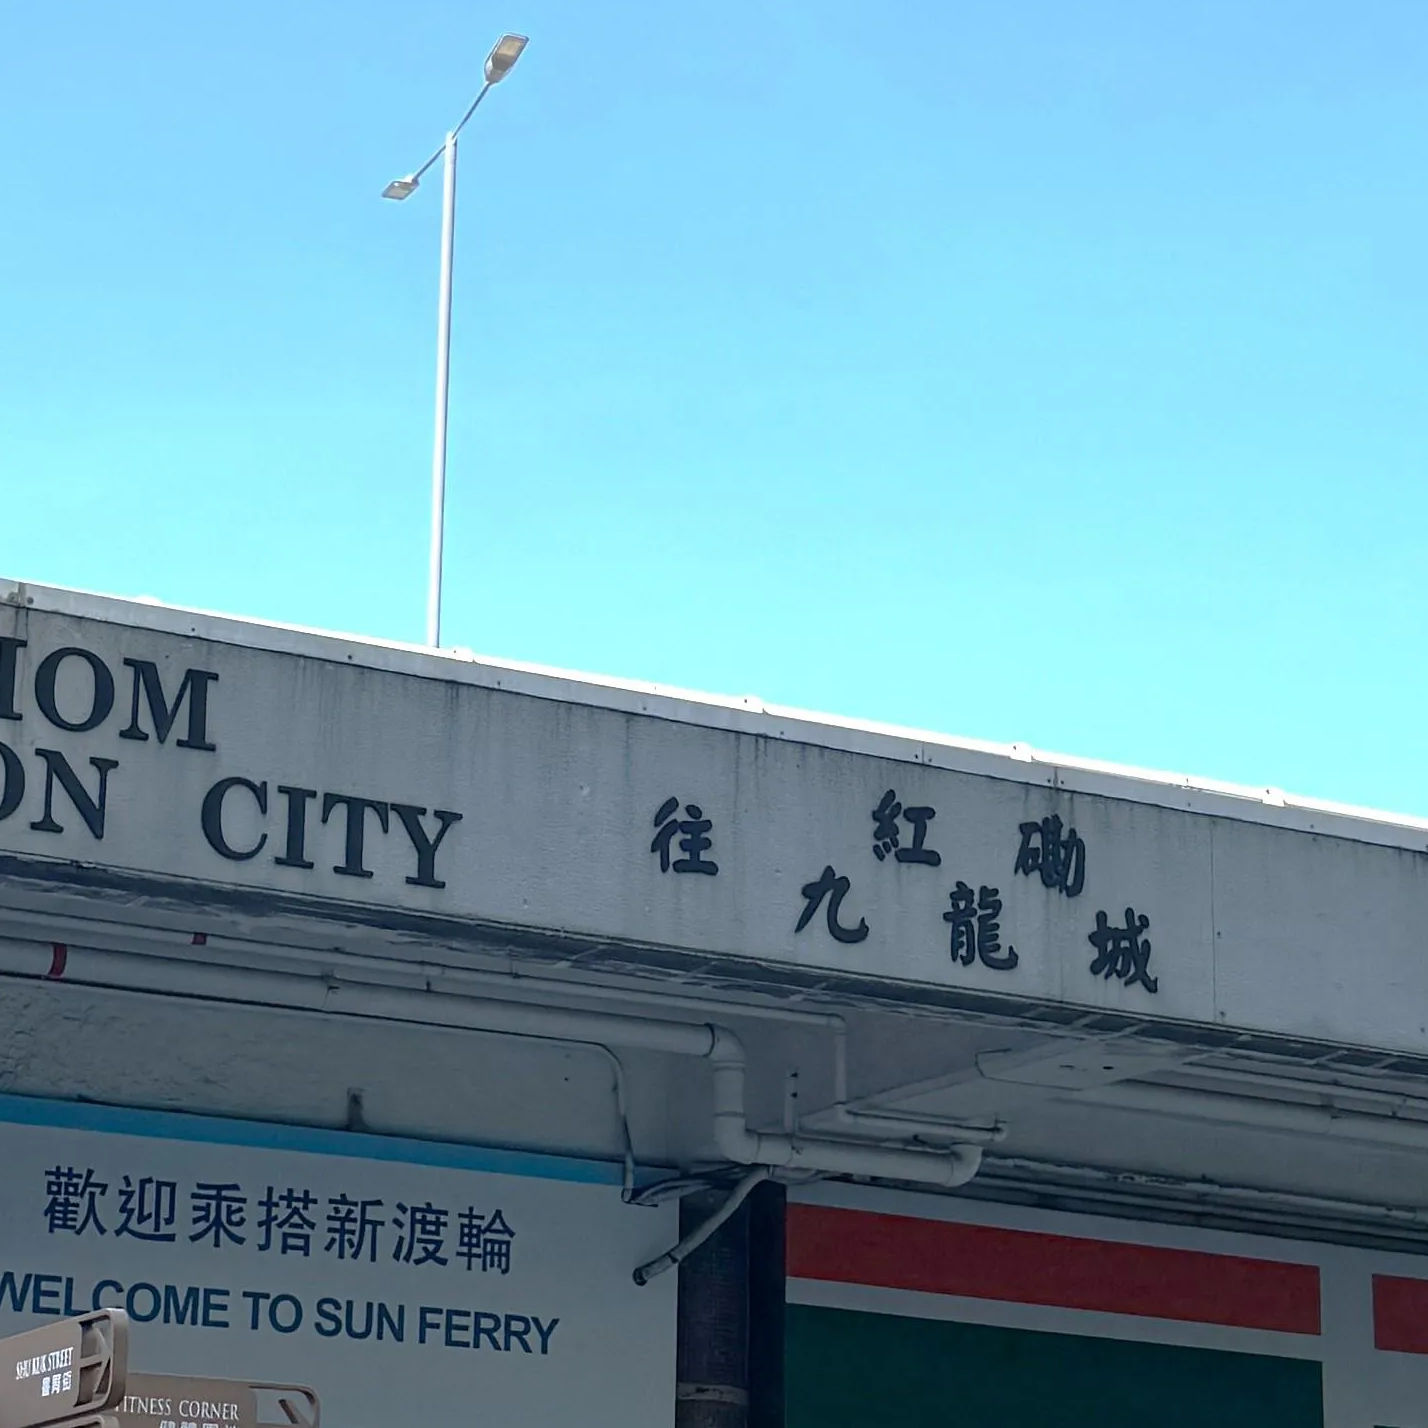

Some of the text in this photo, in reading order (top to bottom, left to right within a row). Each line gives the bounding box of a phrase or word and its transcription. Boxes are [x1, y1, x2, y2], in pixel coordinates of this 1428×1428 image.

[201, 775, 463, 889] CITY
[651, 795, 719, 877] 往
[795, 865, 1158, 993] 九龍城
[44, 1166, 515, 1275] 歡迎乘搭新渡輪
[242, 1289, 302, 1334] TO
[315, 1297, 405, 1343] SUN
[417, 1307, 560, 1355] FERRY
[178, 1399, 239, 1421] CORNER
